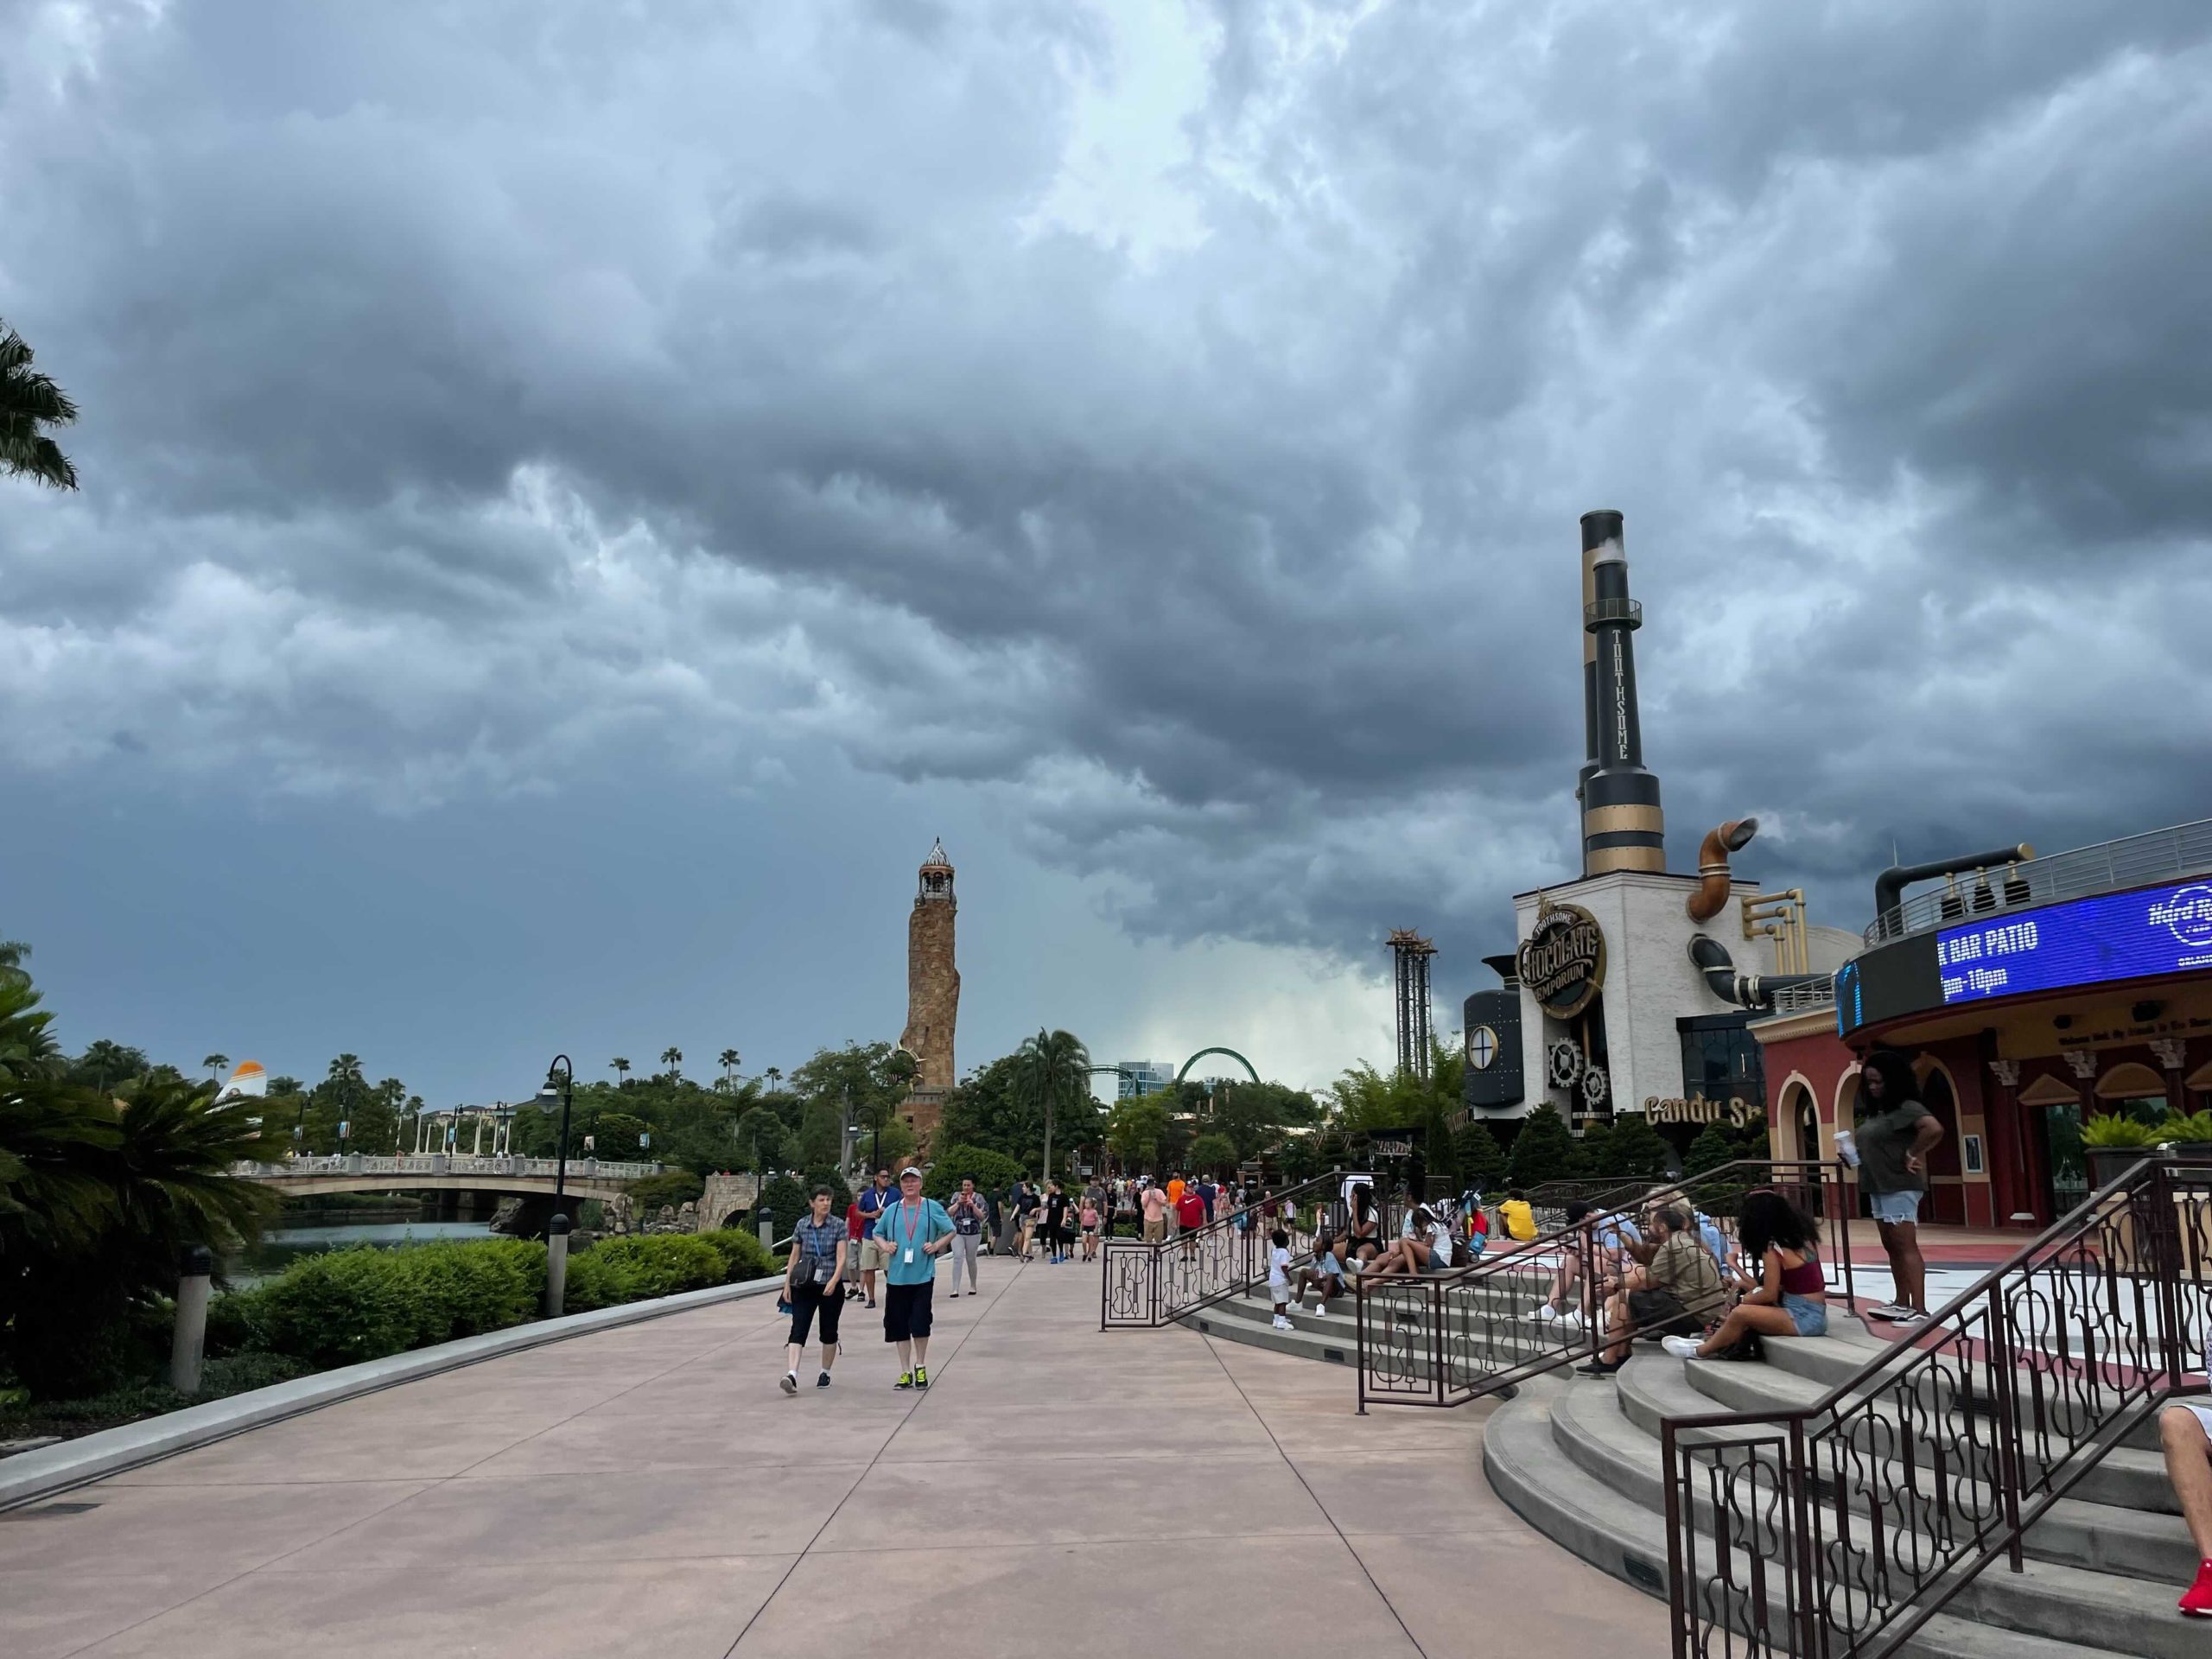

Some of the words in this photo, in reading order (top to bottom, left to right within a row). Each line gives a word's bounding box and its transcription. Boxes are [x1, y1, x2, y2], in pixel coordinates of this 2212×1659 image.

[1612, 629, 1628, 760] TOOTHSOME
[1535, 912, 1571, 936] TOOTHSOME
[1949, 934, 1982, 963] BAR
[1985, 921, 2037, 957] PATIO
[1515, 925, 1598, 988] CHOCOLATE
[1535, 964, 1585, 1001] EMPORIUM
